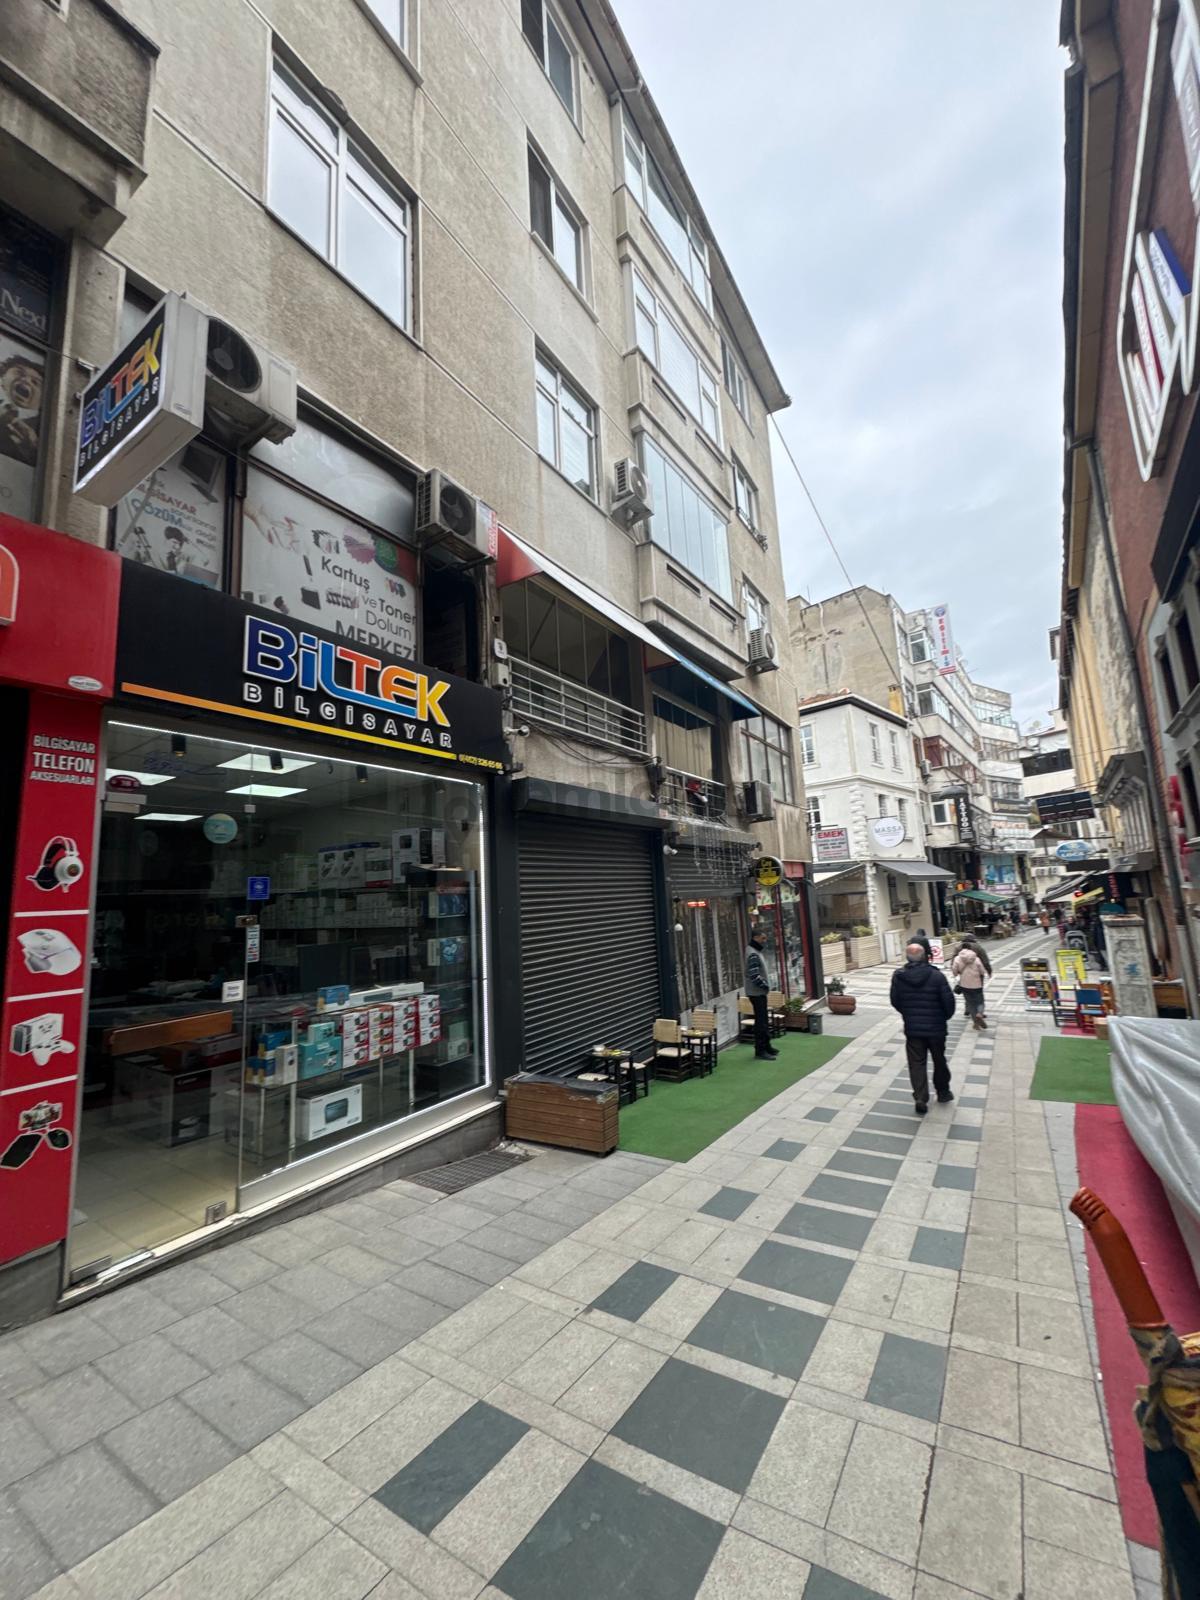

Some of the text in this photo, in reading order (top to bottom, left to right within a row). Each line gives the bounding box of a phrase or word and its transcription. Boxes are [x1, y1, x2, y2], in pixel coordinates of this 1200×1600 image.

[321, 556, 371, 594] Kartuş
[362, 595, 417, 625] ve Toner
[365, 609, 412, 641] Dolum
[243, 681, 453, 749] BİLGİSAYAR
[32, 752, 95, 773] TELEFON
[816, 829, 845, 838] EMEK
